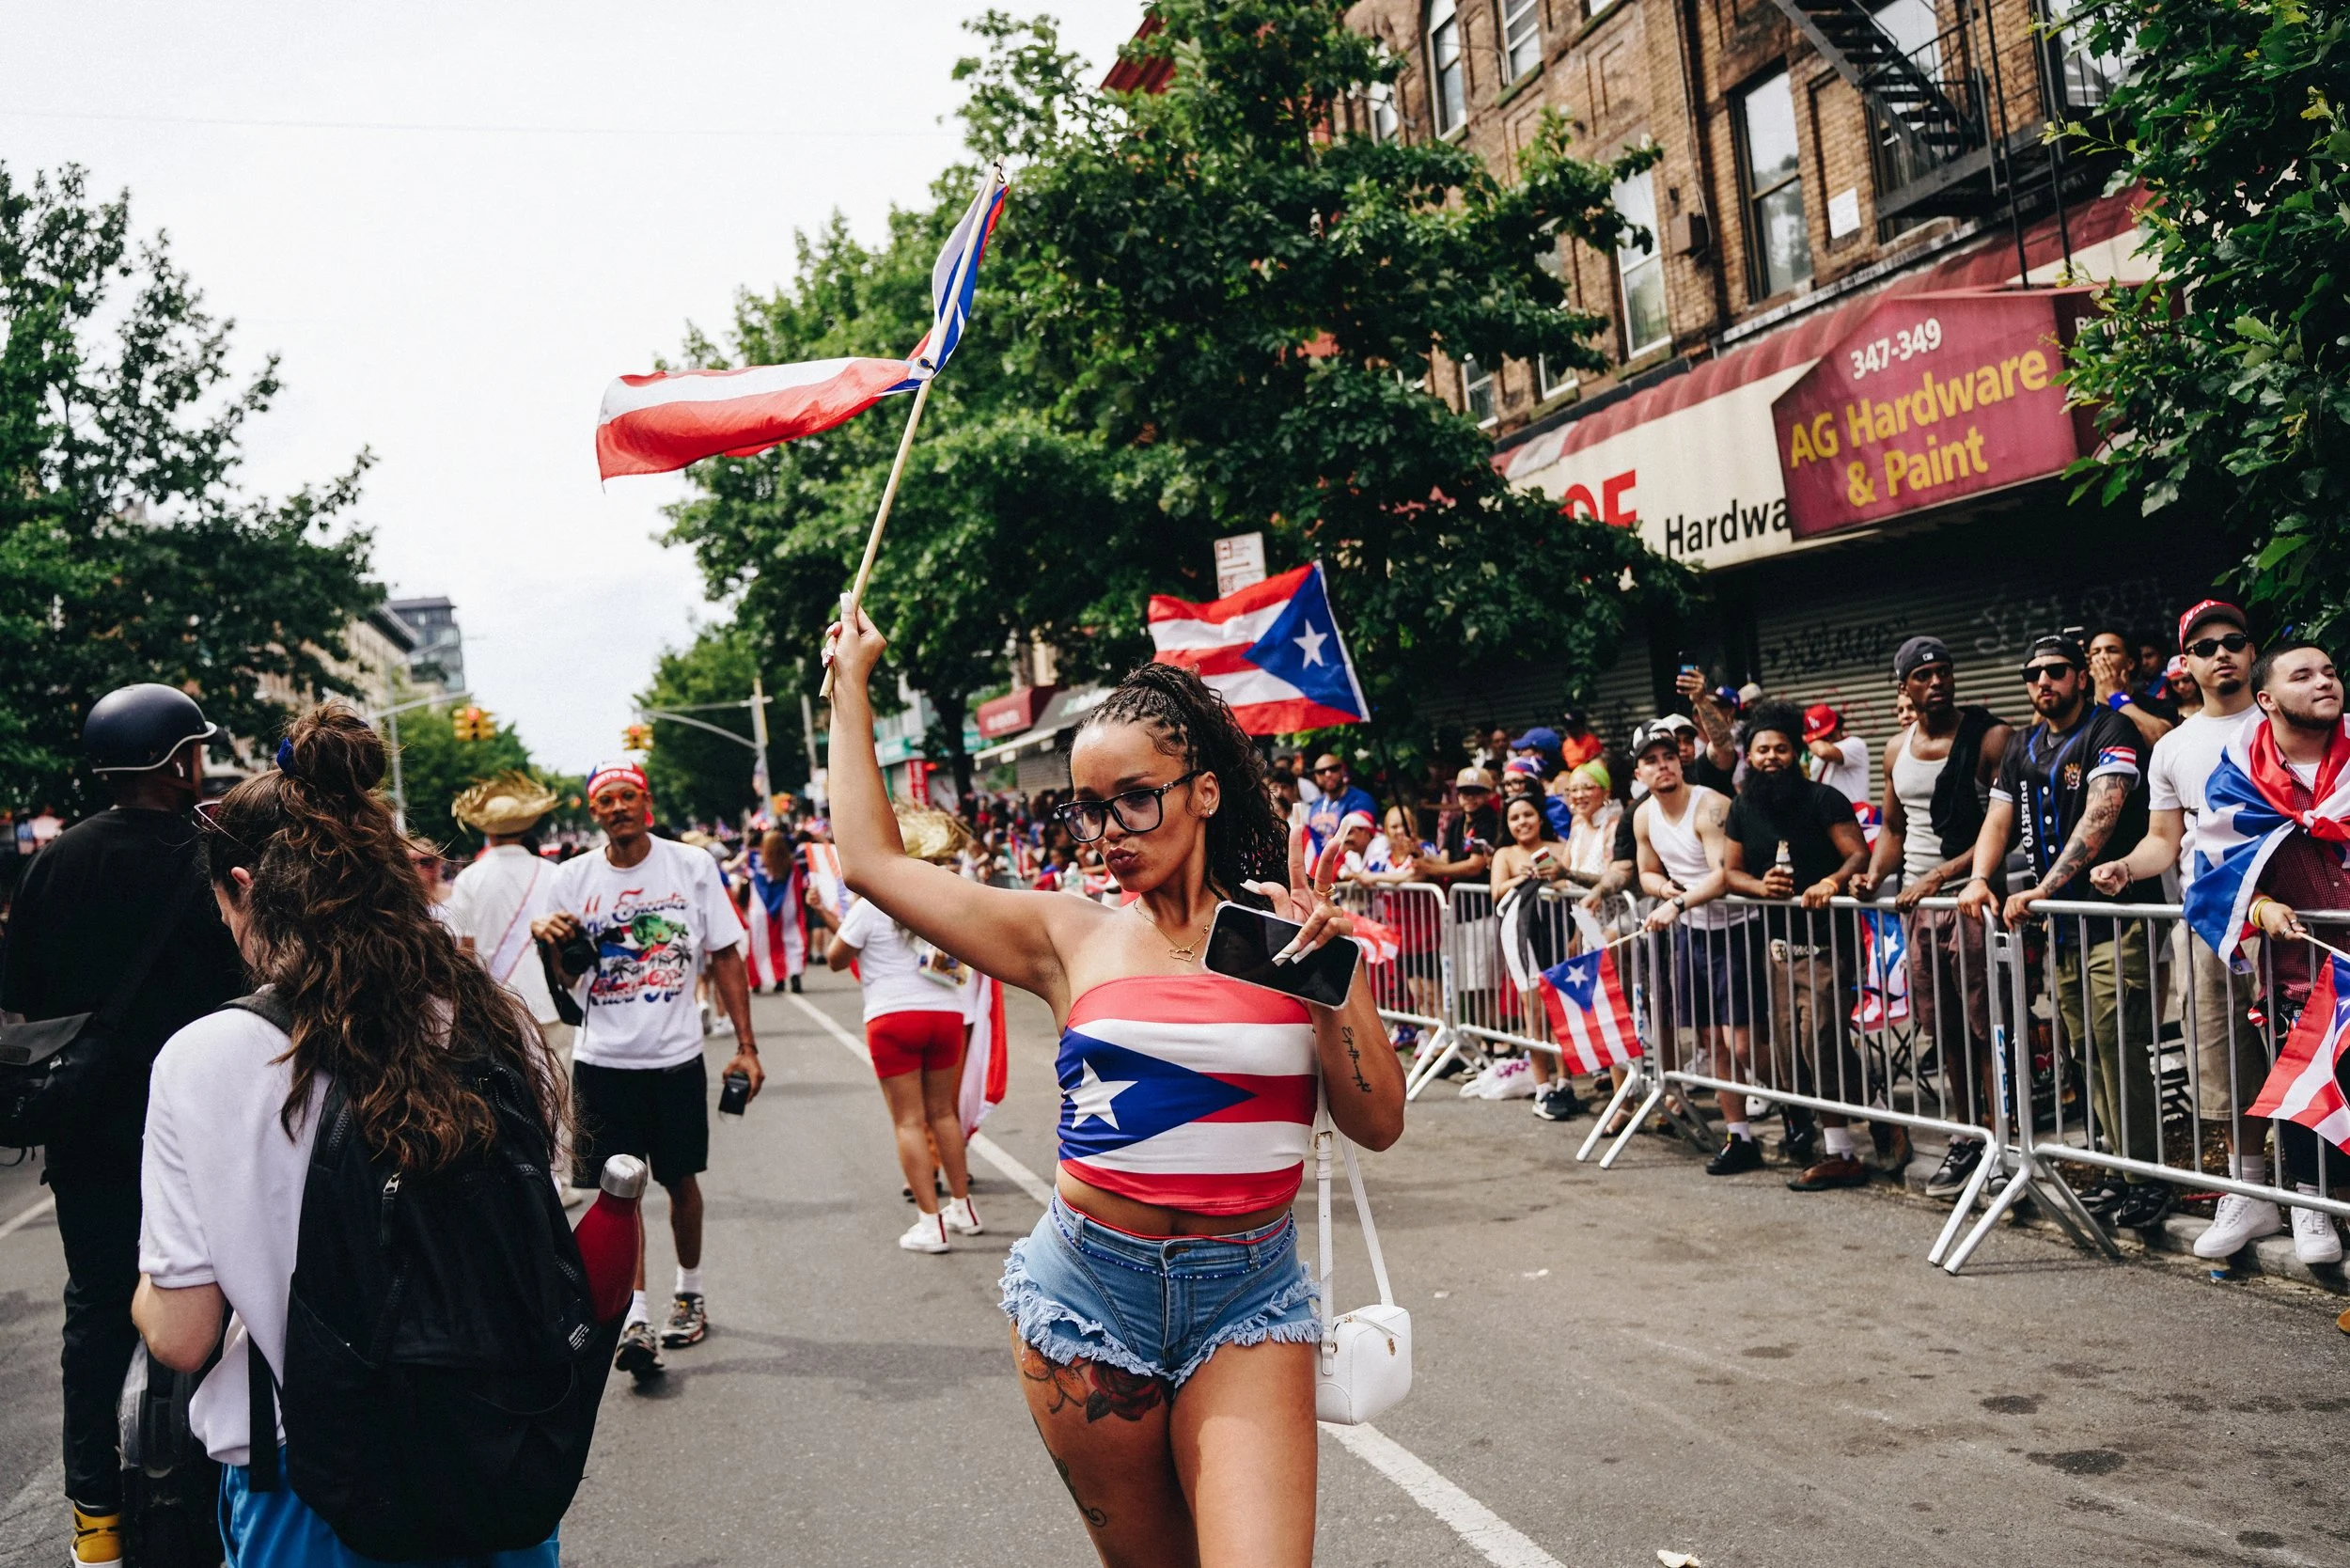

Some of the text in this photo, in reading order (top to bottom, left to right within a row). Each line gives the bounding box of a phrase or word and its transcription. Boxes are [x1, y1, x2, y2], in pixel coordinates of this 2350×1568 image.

[1850, 318, 1942, 380] 347-349
[1791, 349, 2049, 468] AG Hardware
[1846, 426, 1989, 508] & Paint
